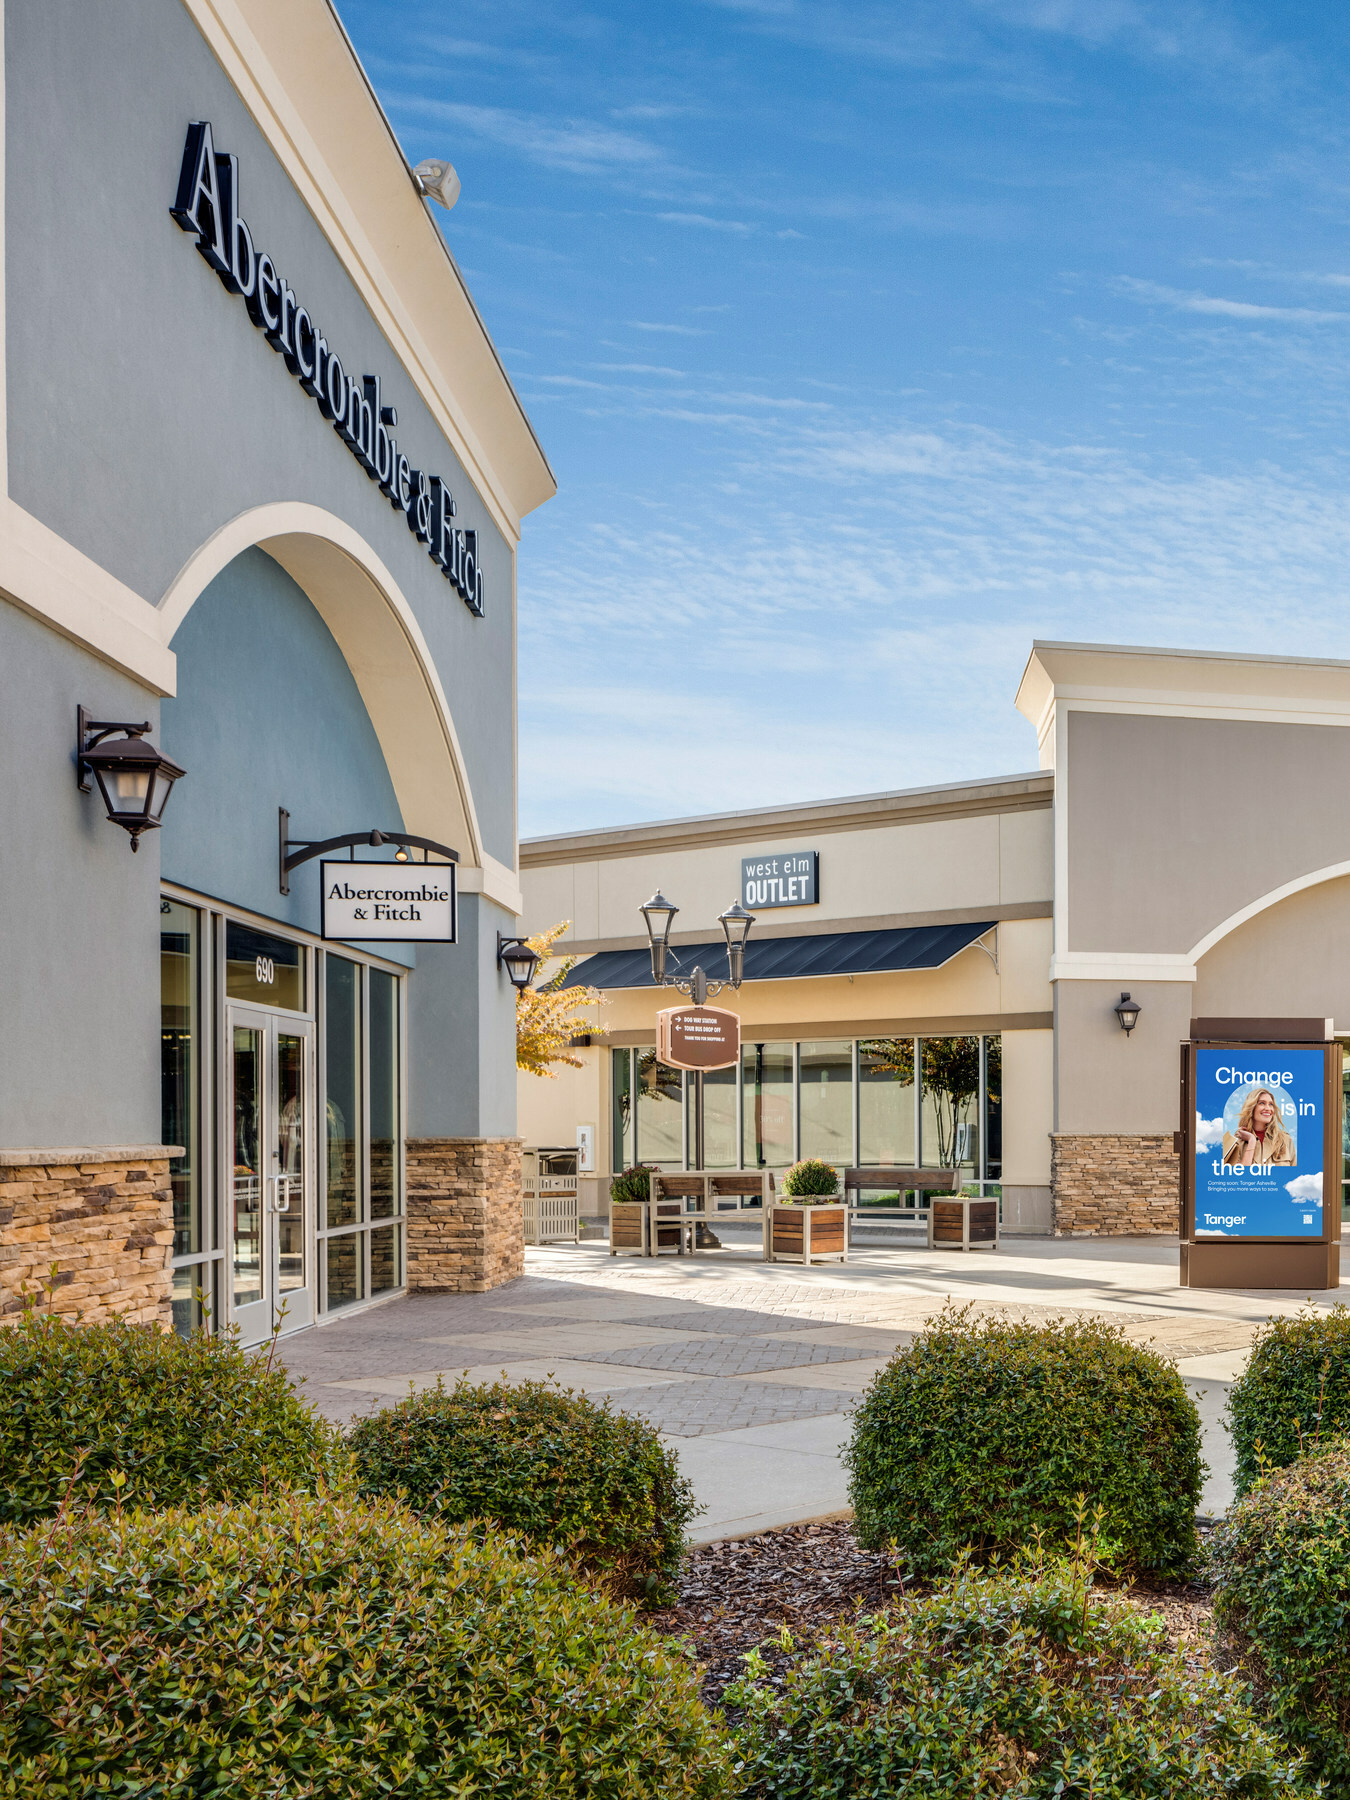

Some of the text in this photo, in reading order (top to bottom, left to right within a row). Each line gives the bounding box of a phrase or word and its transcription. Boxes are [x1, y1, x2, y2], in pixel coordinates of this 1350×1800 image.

[170, 121, 485, 618] Abercrombie & Fitch
[746, 857, 809, 877] west elm
[328, 882, 449, 901] Abercrombie
[746, 876, 809, 905] OUTLET
[353, 904, 422, 921] & Fitch
[255, 955, 274, 984] 690
[1215, 1067, 1294, 1088] Change
[1281, 1098, 1316, 1116] is in
[1212, 1159, 1276, 1176] the air
[1204, 1213, 1246, 1227] Tanger
